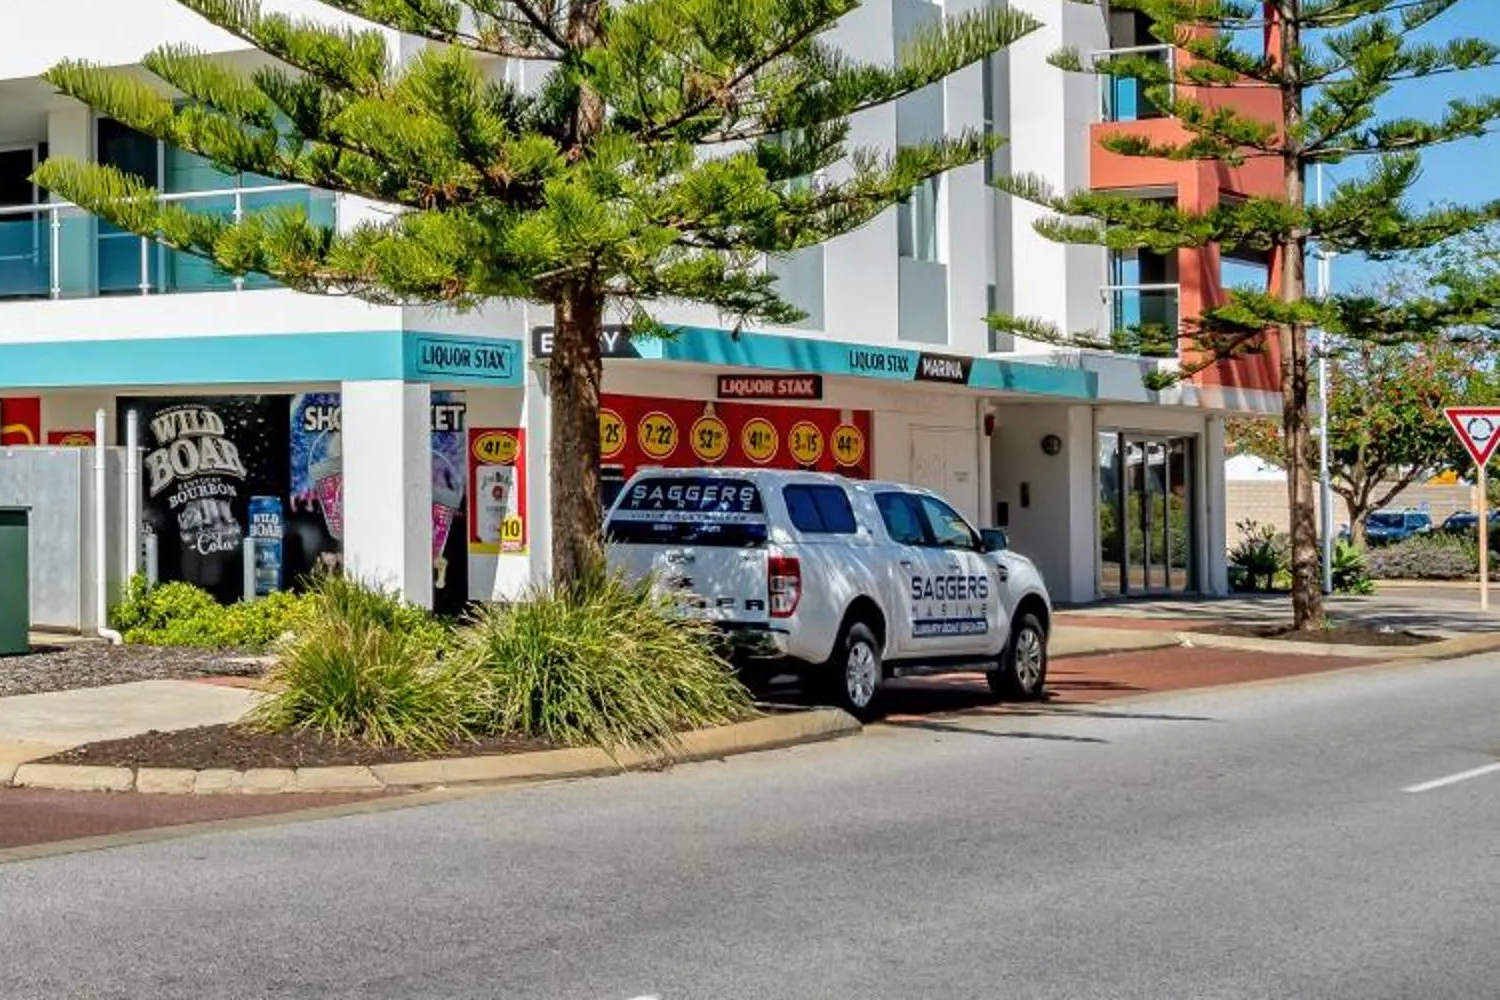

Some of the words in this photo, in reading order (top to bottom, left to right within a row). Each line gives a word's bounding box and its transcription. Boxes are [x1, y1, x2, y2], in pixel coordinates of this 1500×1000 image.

[422, 345, 471, 367] LIQUOR
[474, 350, 506, 371] STAX
[851, 351, 886, 371] LIQUOR
[888, 355, 909, 373] STAX
[922, 357, 964, 379] MARINA
[721, 379, 774, 395] LIQUOR
[778, 379, 815, 395] STAX
[150, 408, 225, 445] WILD
[431, 404, 465, 431] ET
[144, 436, 247, 498] BOAR
[169, 483, 238, 510] BOURBON
[632, 484, 755, 501] SAGGERS
[911, 575, 989, 601] SAGGERS
